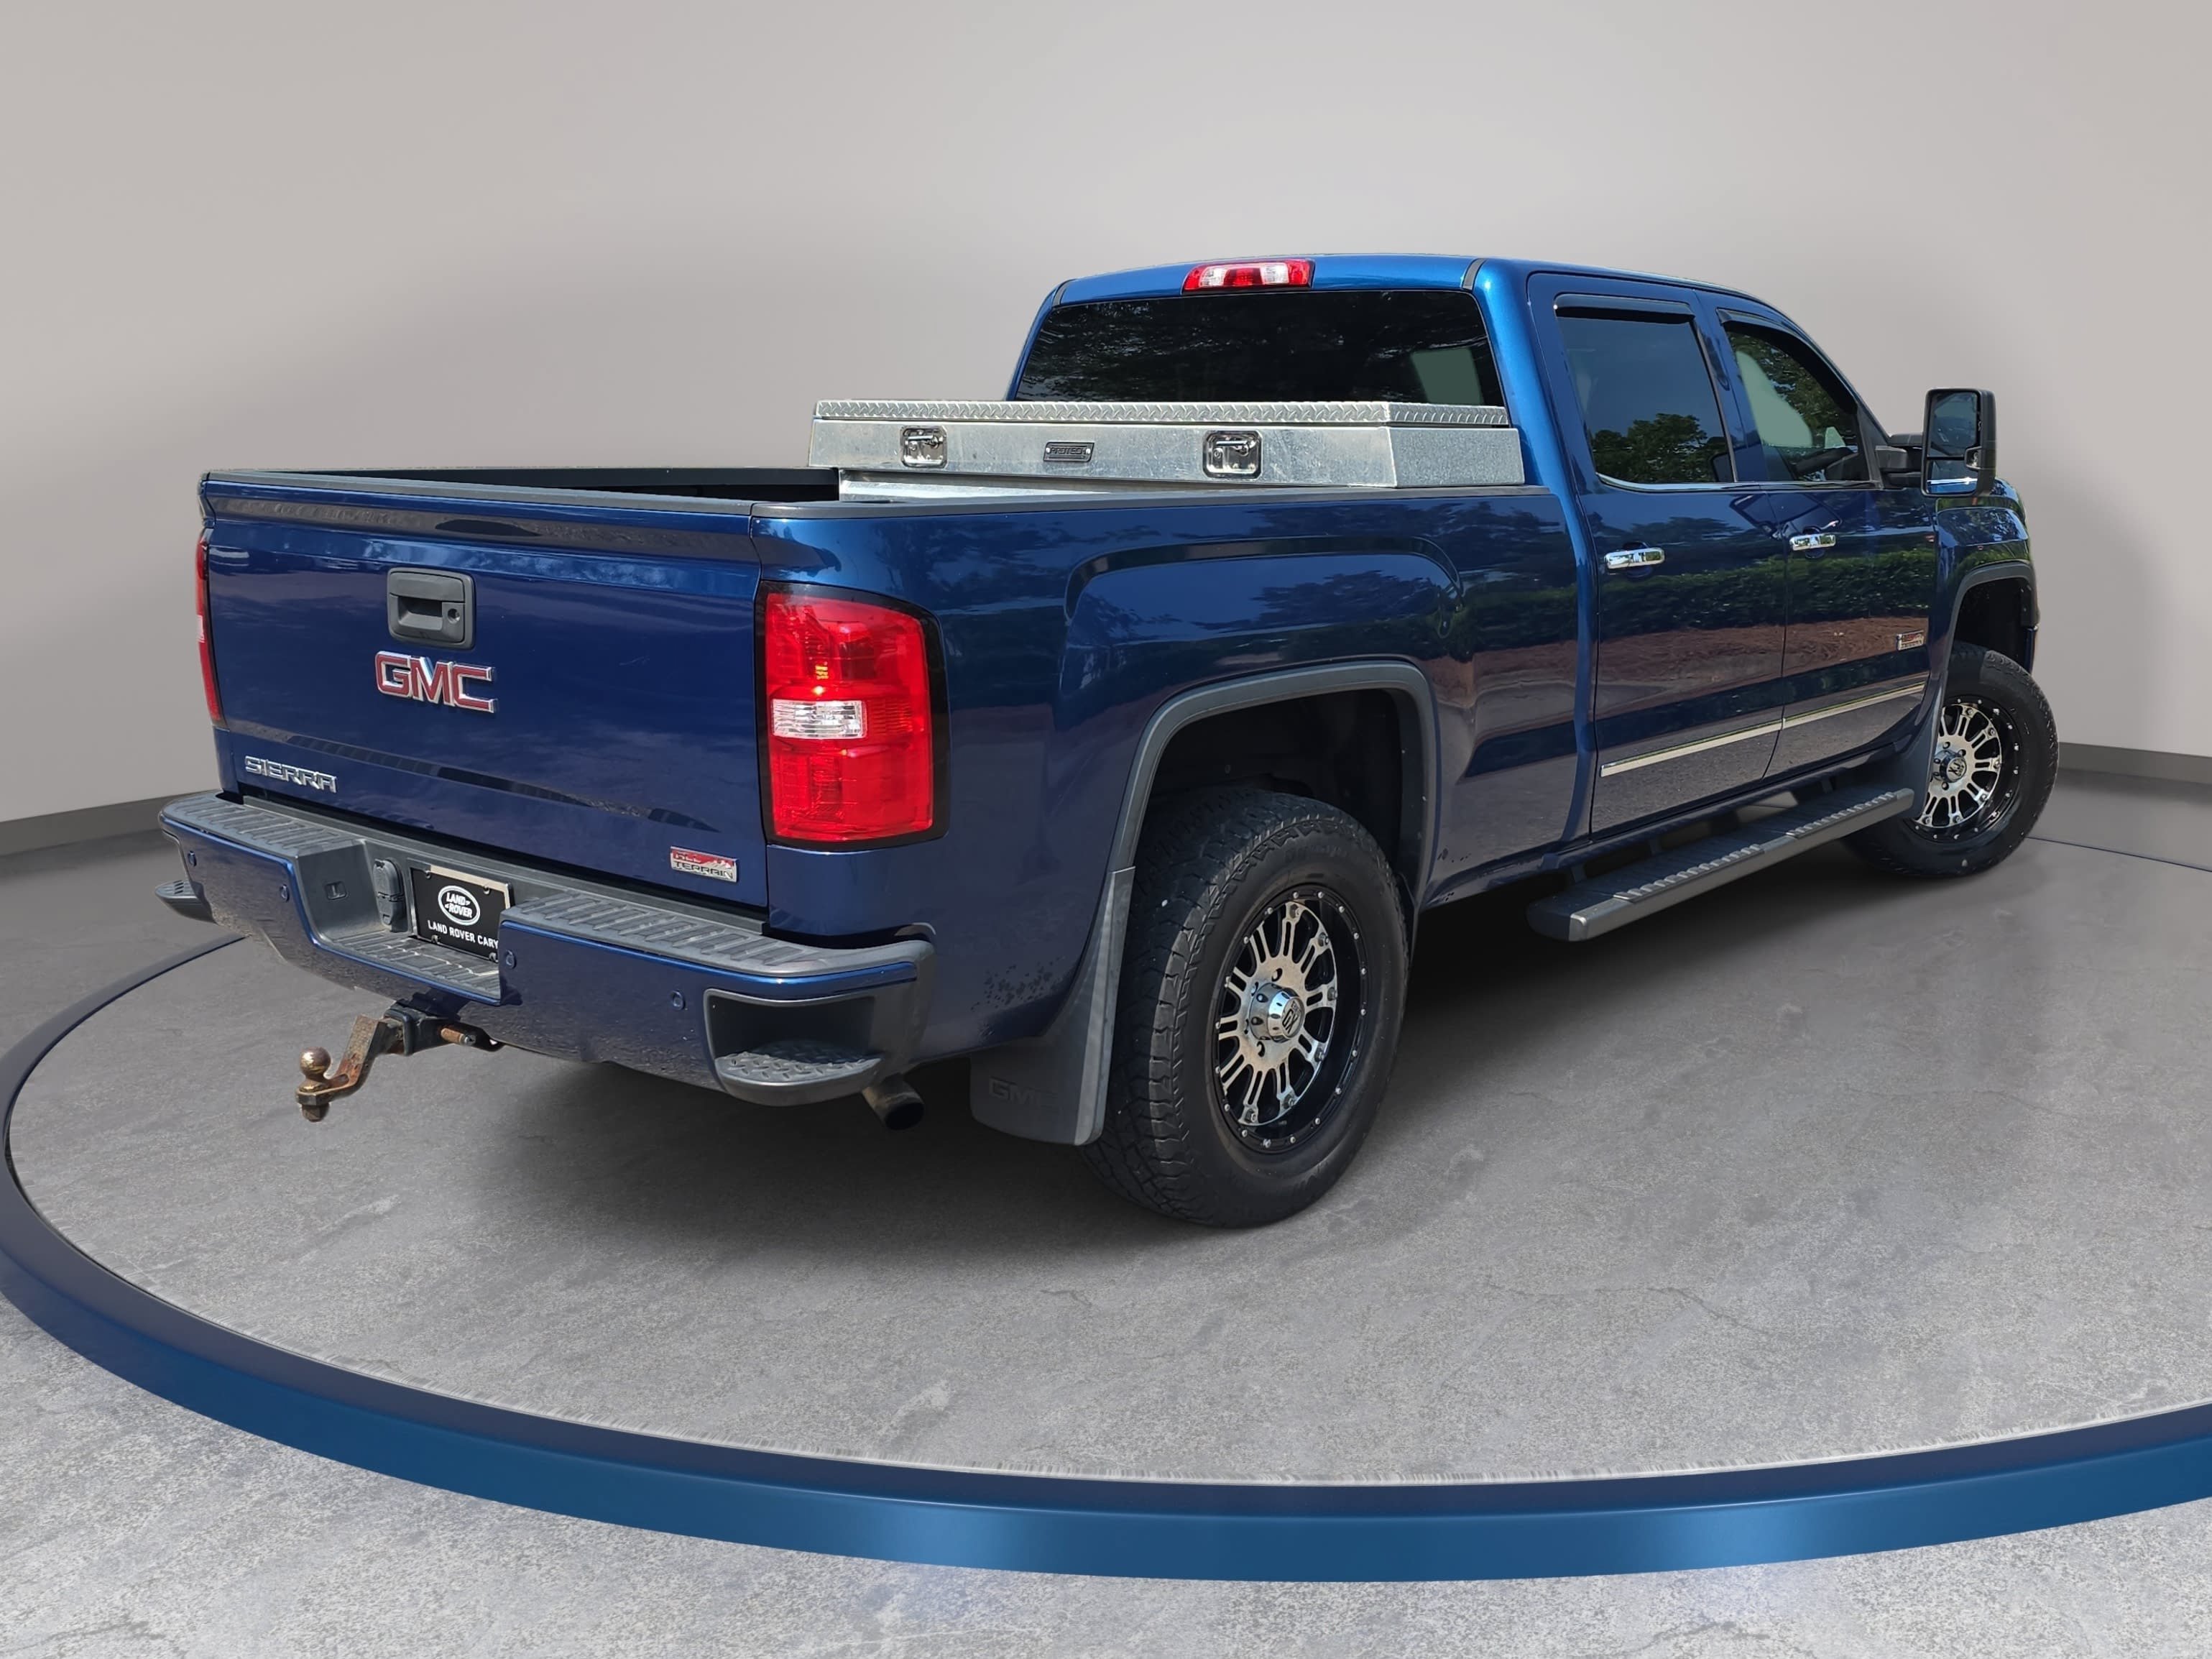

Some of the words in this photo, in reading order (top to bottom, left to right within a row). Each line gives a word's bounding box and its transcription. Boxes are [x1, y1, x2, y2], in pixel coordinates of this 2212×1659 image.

[375, 651, 495, 714] GMC
[245, 755, 337, 794] SIERRA
[676, 862, 733, 879] TERRAIN
[446, 892, 466, 906] LAND
[448, 903, 472, 918] ROVER
[428, 919, 448, 934] LAND
[449, 927, 476, 943] ROVER
[477, 935, 499, 949] CARY
[989, 1075, 1059, 1114] GMC
